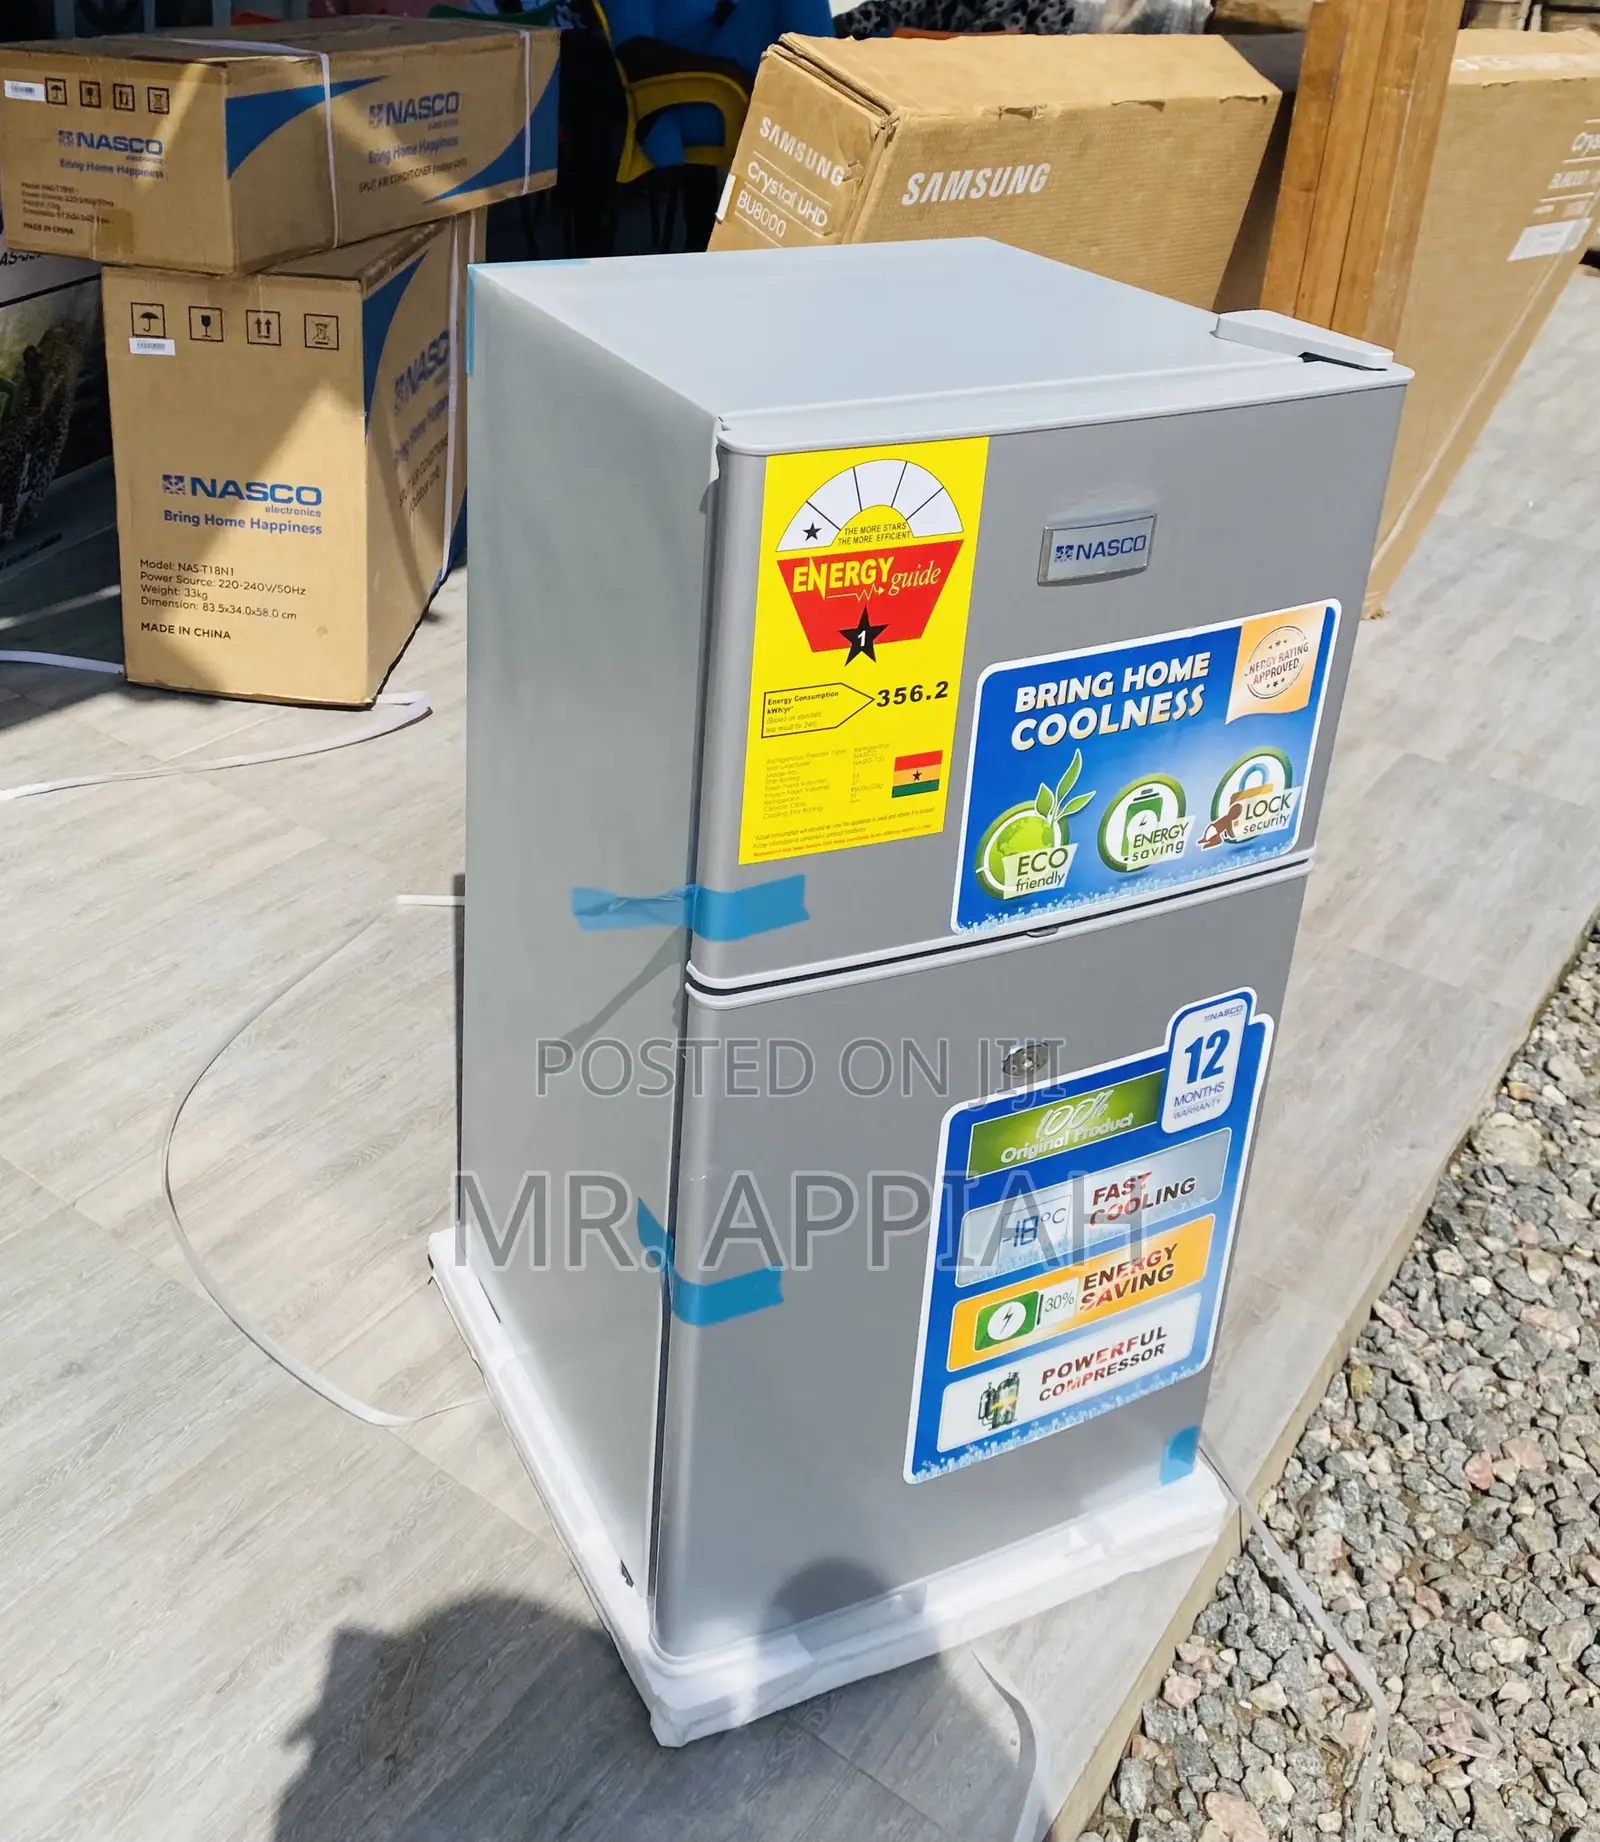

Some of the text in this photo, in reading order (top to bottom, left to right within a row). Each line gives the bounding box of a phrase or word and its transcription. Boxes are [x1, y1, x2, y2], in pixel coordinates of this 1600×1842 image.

[386, 91, 460, 126] NASCO
[76, 131, 163, 155] NASCO
[759, 116, 845, 187] SAMSUNG
[86, 162, 114, 174] Home
[747, 161, 829, 227] Crystal UHD
[902, 163, 1051, 206] SAMSUNG
[737, 189, 788, 238] BU8000
[190, 477, 322, 506] NASCO
[163, 510, 322, 535] Bring Home Happiness
[265, 505, 322, 517] electronics
[838, 531, 911, 546] THE MORE EFFICIENT
[844, 522, 907, 536] THE MORE STARS
[1076, 535, 1146, 560] NASCO
[140, 559, 234, 577] Model: NAS-T18N1
[792, 556, 942, 601] ENERGY guide
[140, 572, 307, 596] Power Source: 220-240V/50Hz
[140, 584, 208, 601] Weight: 33kg
[141, 596, 297, 620] Dimension: 83.5x34.0x58.0 cm
[141, 622, 231, 640] MADE IN CHINA
[857, 630, 867, 647] 1
[1278, 642, 1309, 663] RATING
[1014, 652, 1212, 714] BRING HOME
[1253, 658, 1300, 686] APPROVED
[768, 691, 839, 706] Energy Consumption
[876, 680, 949, 708] 356.2
[1010, 683, 1207, 751] COOLNESS
[1245, 791, 1292, 821] LOCK
[1133, 821, 1190, 849] ENERGY
[1243, 813, 1290, 835] security
[1016, 846, 1068, 877] ECO
[1132, 838, 1185, 863] saving
[1016, 870, 1066, 893] friendly
[1210, 1004, 1243, 1020] NASCO
[1184, 1028, 1230, 1085] 12
[1174, 1081, 1225, 1107] MONTHS
[1036, 1089, 1115, 1140] 100%
[1173, 1099, 1220, 1120] WARRANTY
[1001, 1112, 1134, 1163] Original Product
[1089, 1177, 1196, 1226] COOLING
[1092, 1171, 1152, 1207] FAST
[1082, 1243, 1178, 1292] ENERGY
[1079, 1263, 1175, 1311] SAVING
[1044, 1290, 1075, 1314] 30%
[1041, 1326, 1167, 1385] POWERFUL
[1038, 1343, 1165, 1402] COMPRESSOR
